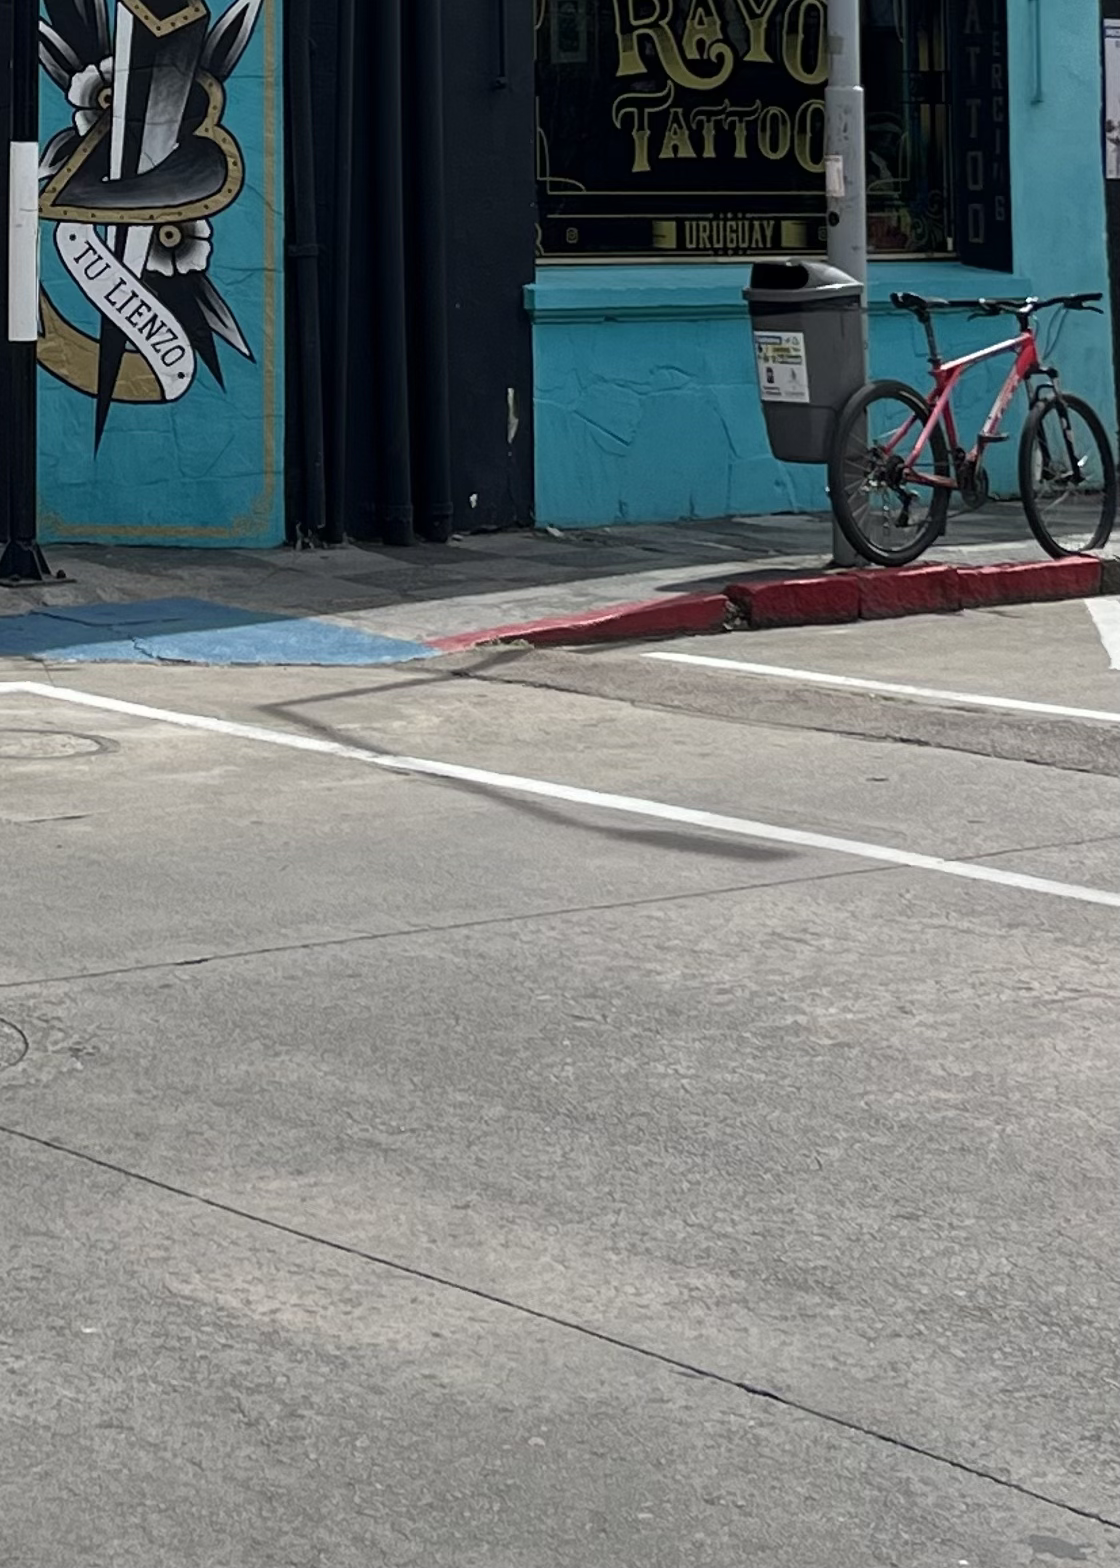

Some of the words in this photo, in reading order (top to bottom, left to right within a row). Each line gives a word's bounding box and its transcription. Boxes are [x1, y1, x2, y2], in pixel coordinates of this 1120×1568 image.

[612, 82, 827, 173] TATTOO
[684, 219, 775, 250] URUGUAY
[73, 240, 111, 280] TU
[103, 277, 186, 368] LIENZO
